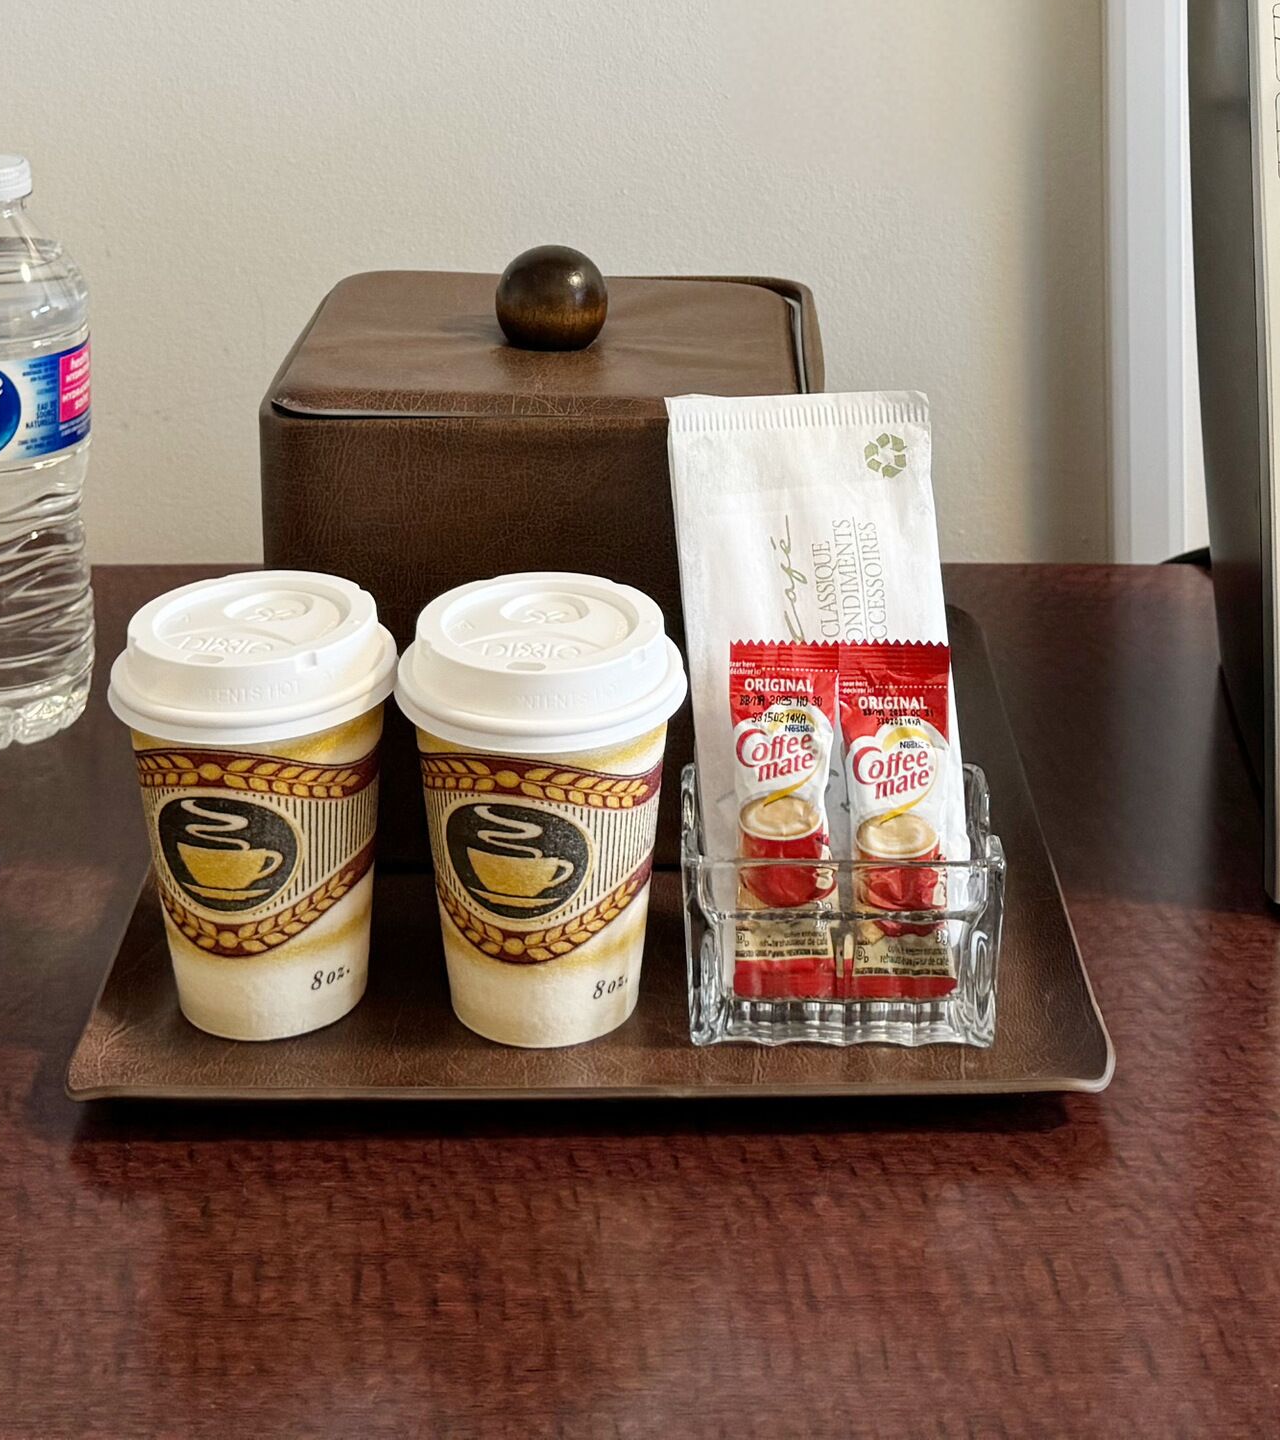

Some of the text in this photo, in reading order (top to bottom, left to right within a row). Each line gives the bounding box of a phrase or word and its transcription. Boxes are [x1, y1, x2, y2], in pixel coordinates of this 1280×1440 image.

[769, 514, 808, 646] Café
[811, 540, 840, 638] CLASSIQUE
[831, 519, 865, 644] ONDIMENTS
[857, 522, 889, 642] CCESSOIRES
[744, 678, 814, 693] ORIGINAL
[769, 695, 792, 706] 2025
[811, 696, 823, 707] 30
[858, 696, 928, 710] ORIGINAL
[736, 728, 813, 768] Coffee
[758, 753, 814, 782] mate
[852, 746, 929, 785] Coffee
[875, 769, 930, 800] mate
[311, 966, 351, 991] 8 oz.
[593, 974, 629, 1000] 8 oz.
